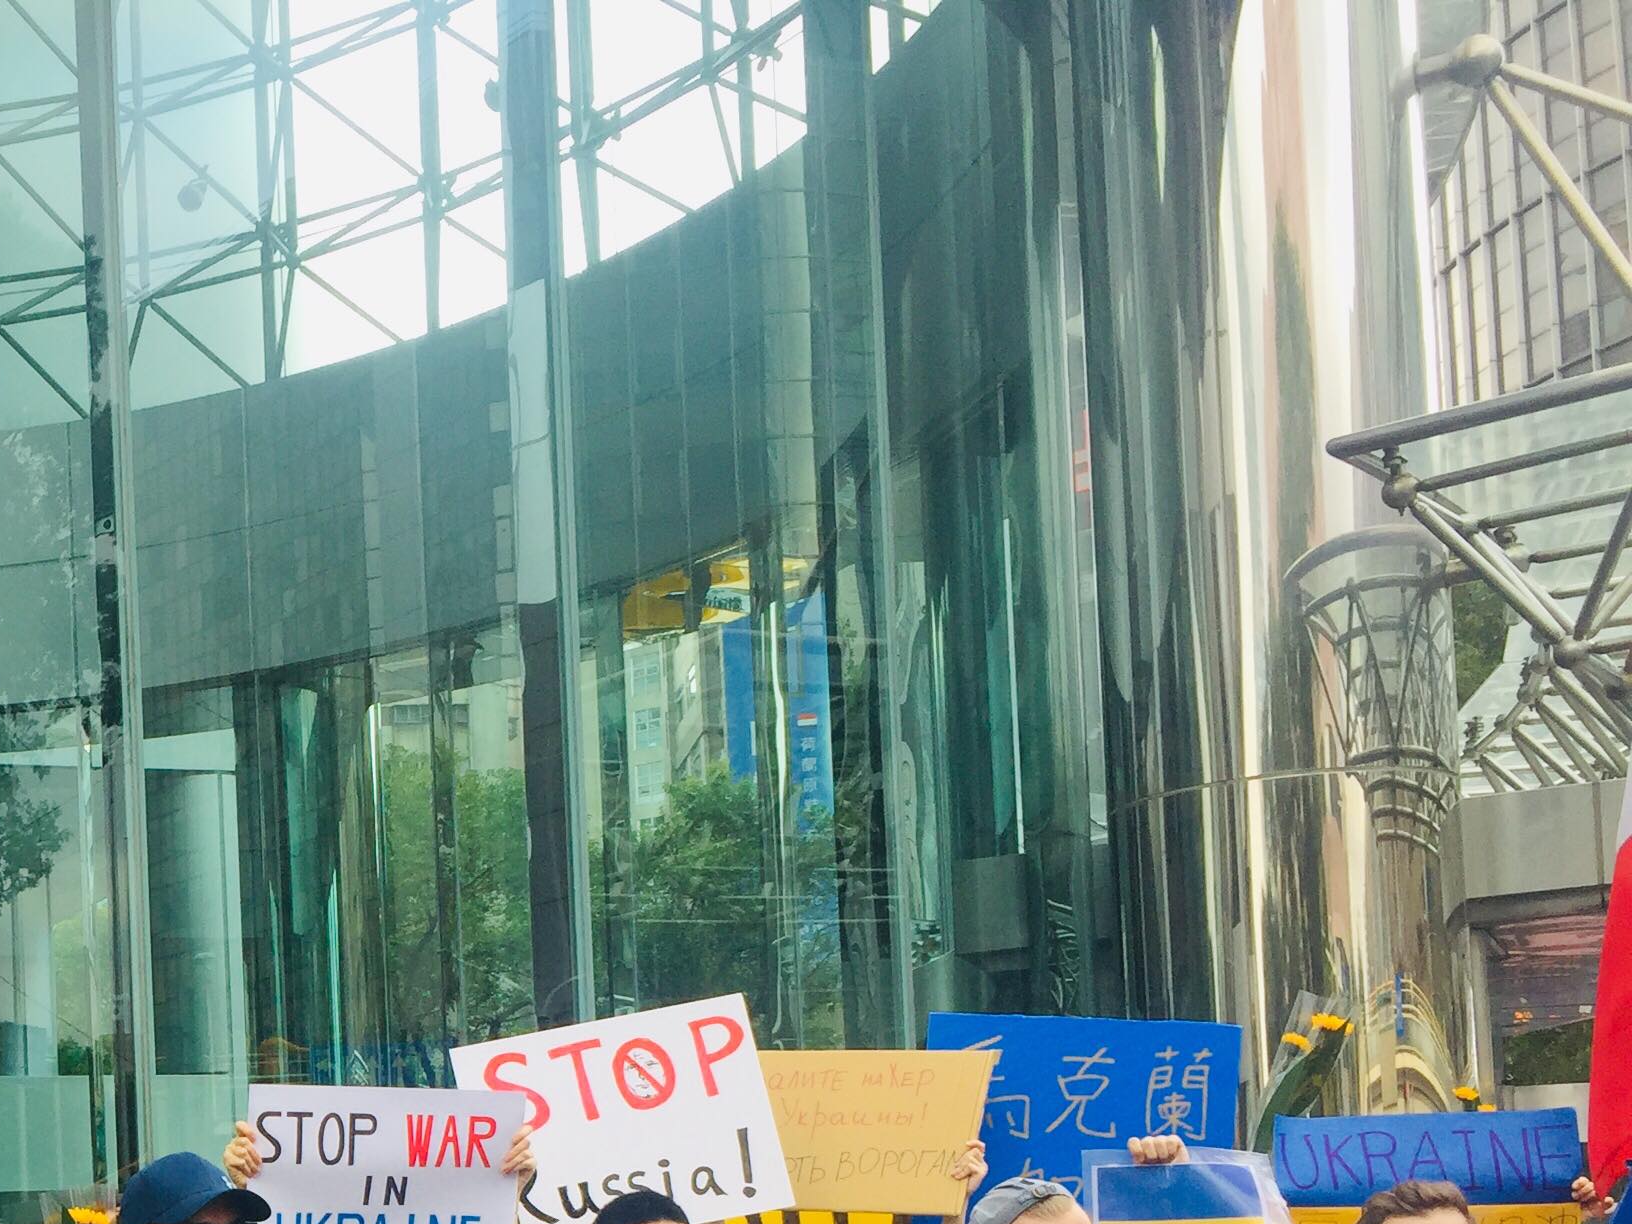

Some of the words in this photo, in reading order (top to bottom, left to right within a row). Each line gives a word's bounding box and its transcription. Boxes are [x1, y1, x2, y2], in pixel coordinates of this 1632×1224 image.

[483, 1015, 745, 1132] STOP
[256, 1110, 378, 1167] STOP
[406, 1113, 497, 1169] WAR
[1278, 1122, 1574, 1192] UKRAINE
[362, 1175, 408, 1206] IN
